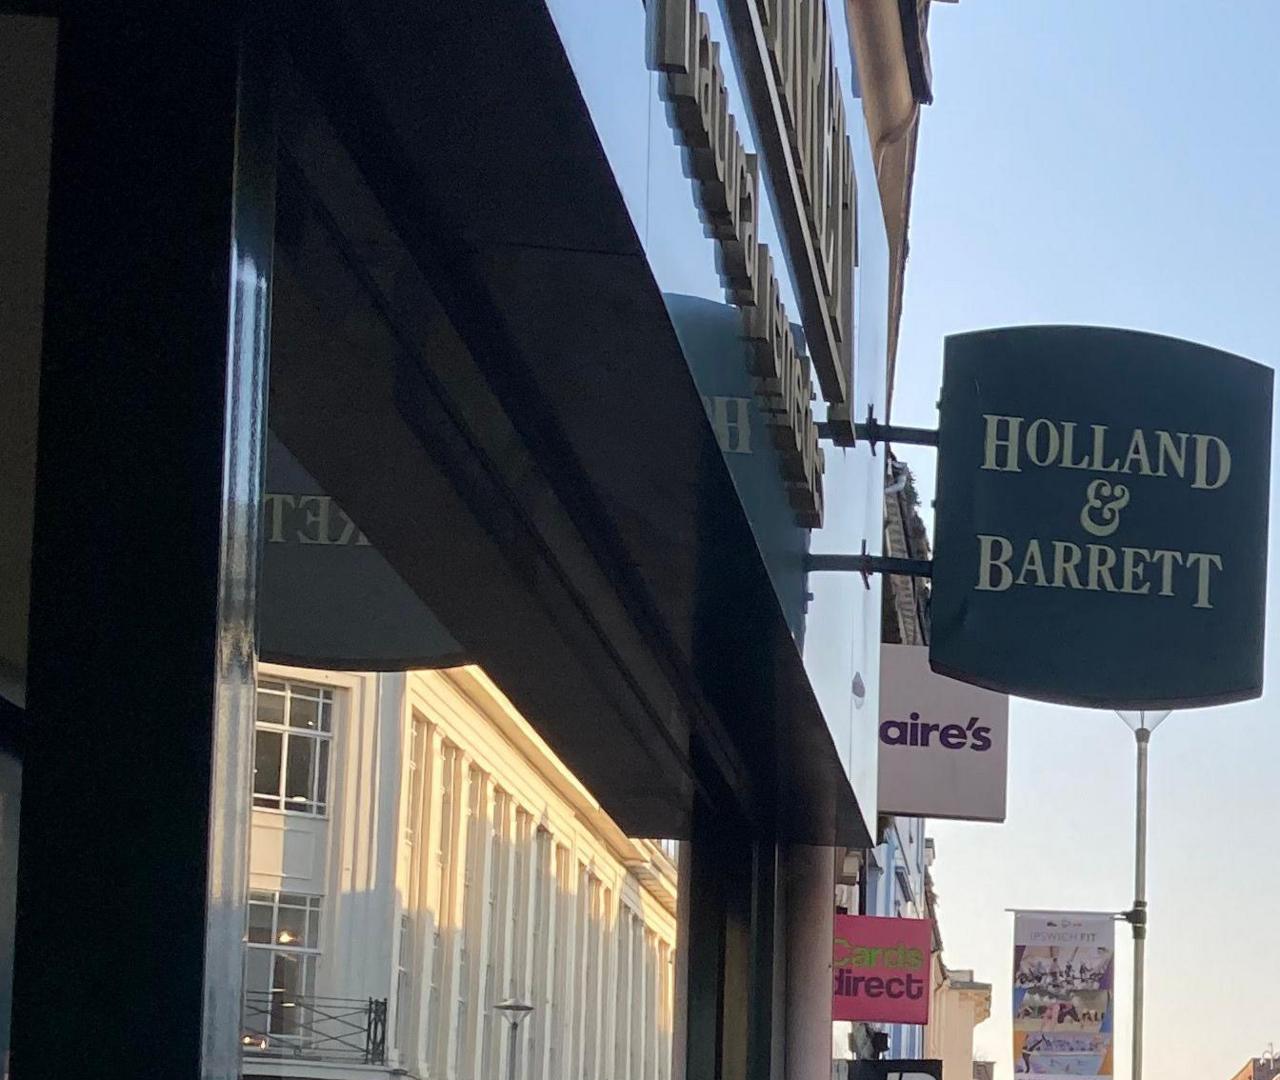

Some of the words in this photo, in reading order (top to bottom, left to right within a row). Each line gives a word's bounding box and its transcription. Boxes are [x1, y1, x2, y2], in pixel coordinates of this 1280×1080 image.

[980, 414, 1232, 491] HOLLAND
[1080, 479, 1130, 537] &
[974, 534, 1224, 610] BARRETT
[879, 711, 992, 753] aire's
[833, 939, 923, 970] Cards
[833, 969, 924, 1001] direct
